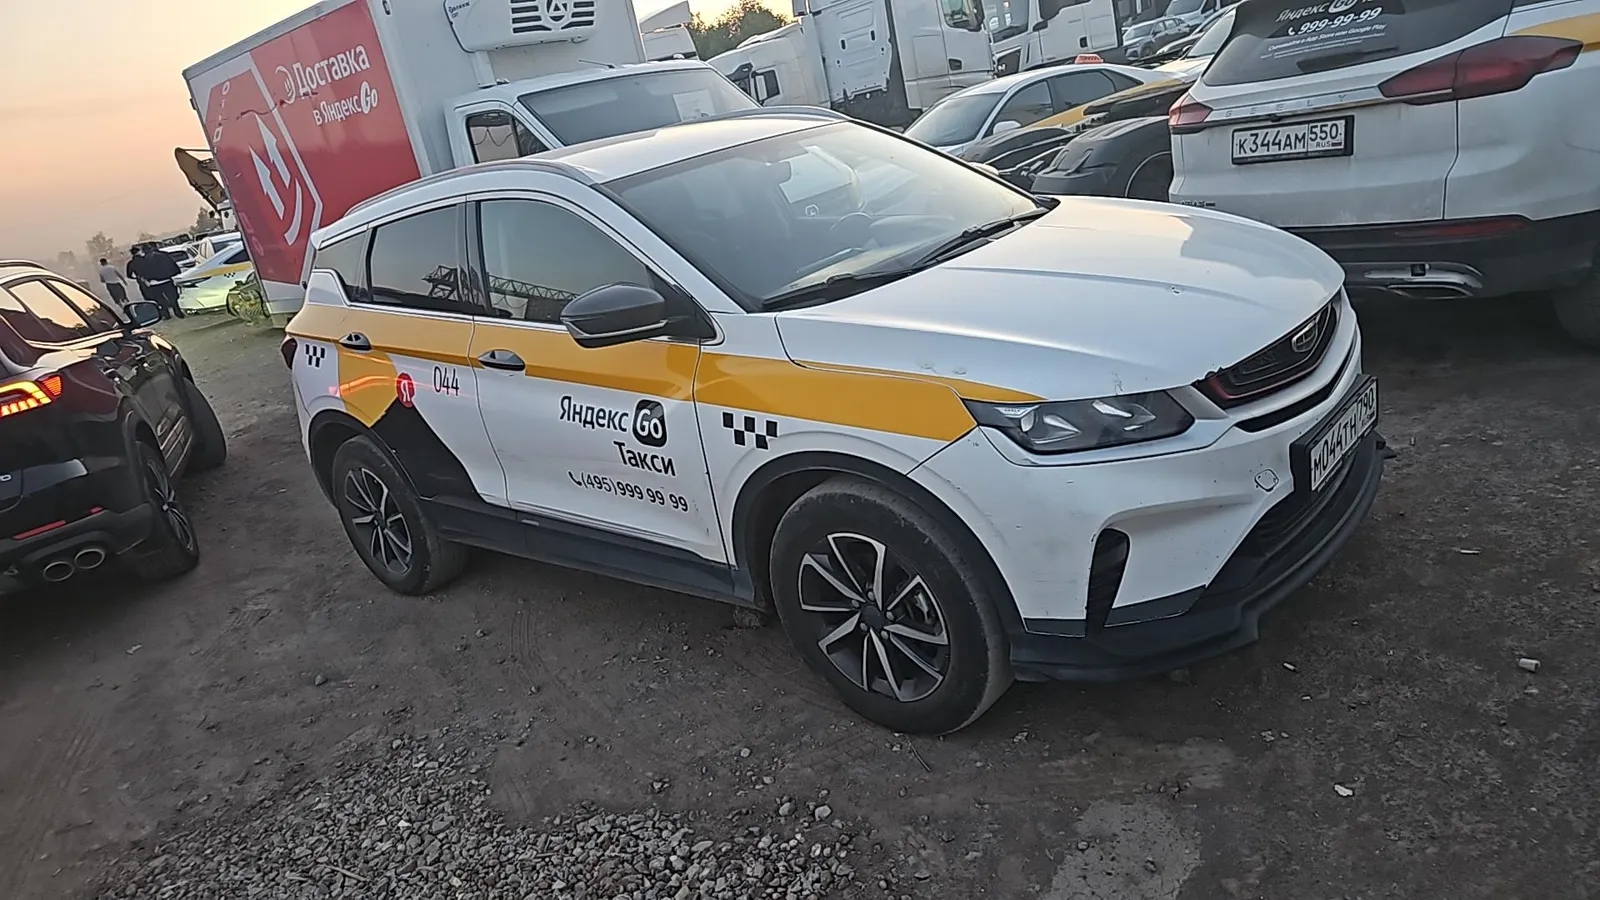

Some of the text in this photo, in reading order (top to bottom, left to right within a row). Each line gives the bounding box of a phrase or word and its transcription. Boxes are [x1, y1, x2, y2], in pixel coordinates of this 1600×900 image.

[1275, 2, 1330, 22] Яндекс
[1298, 7, 1383, 35] 999-99-99
[293, 45, 370, 99] Доставка
[313, 81, 379, 126] в Яндекс Go
[1225, 94, 1346, 117] GEELY
[1238, 123, 1339, 155] К344АМ 550
[434, 366, 460, 396] 044
[560, 396, 663, 439] Яндекс Go
[613, 440, 676, 477] Такси
[646, 488, 665, 506] 99
[669, 494, 688, 512] 99
